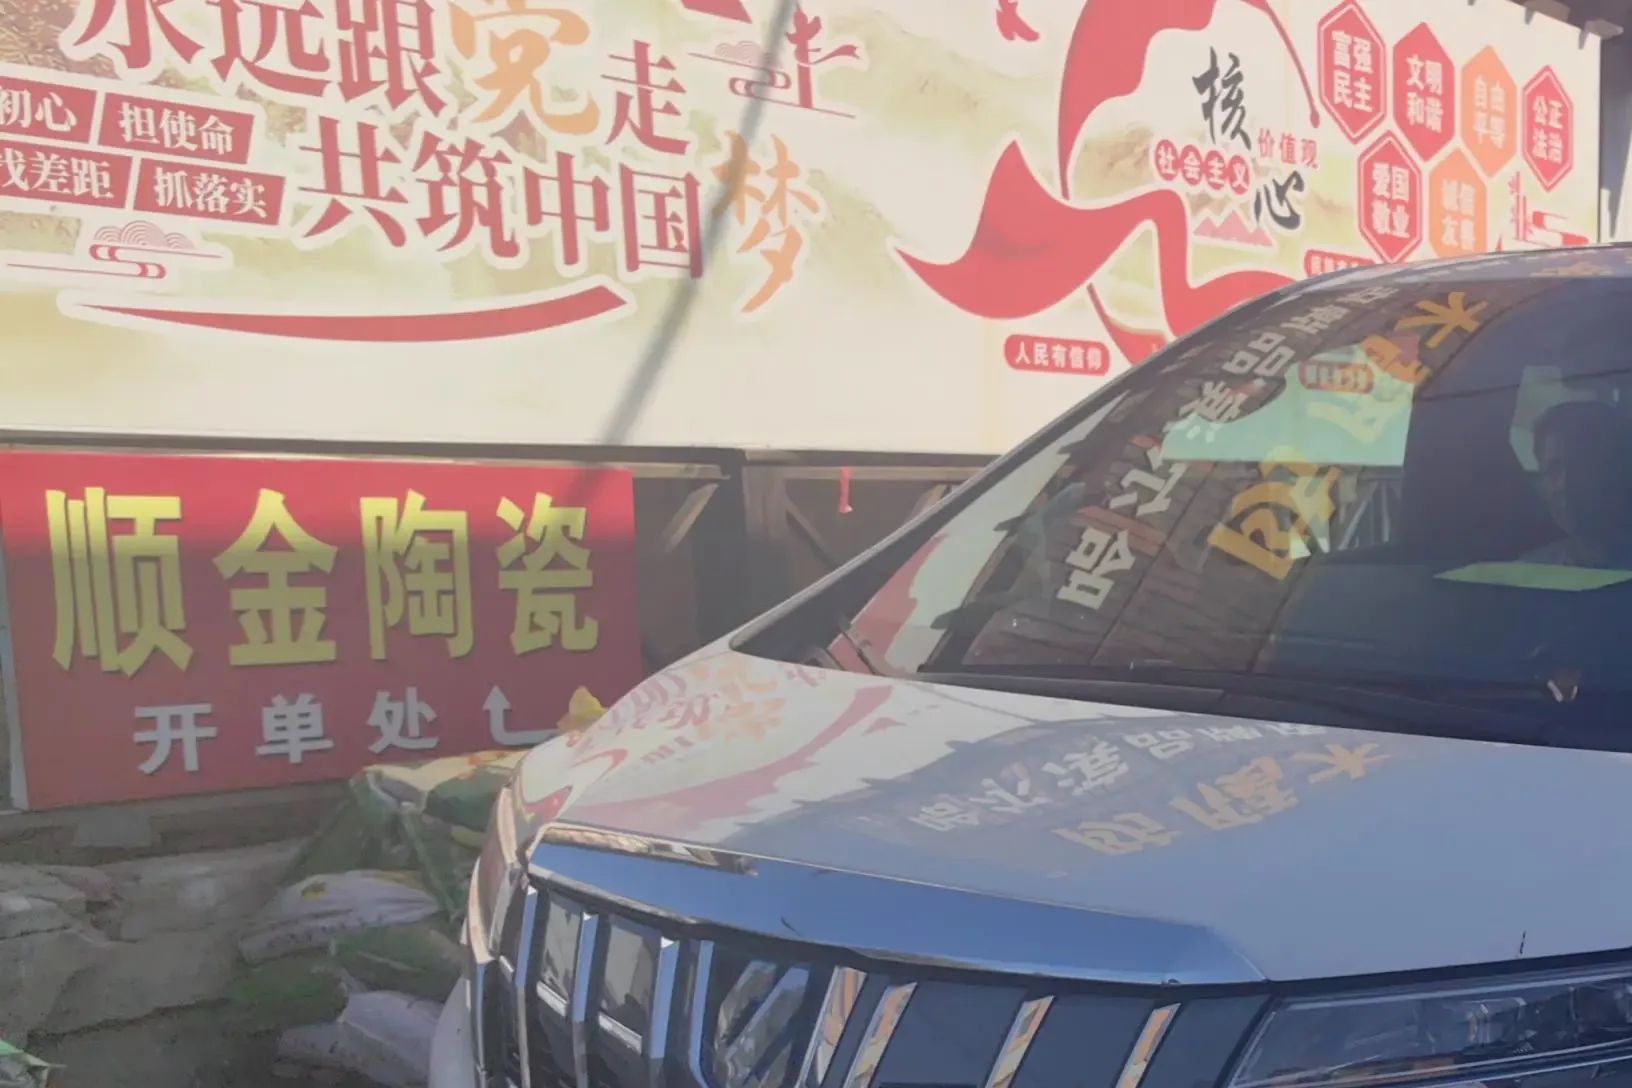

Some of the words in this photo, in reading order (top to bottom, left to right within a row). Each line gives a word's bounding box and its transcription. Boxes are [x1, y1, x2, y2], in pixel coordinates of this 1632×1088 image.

[1331, 30, 1374, 74] 富强
[1332, 70, 1373, 113] 民主
[1406, 54, 1443, 95] 文明
[1191, 46, 1252, 151] 核
[1406, 92, 1443, 133] 和谐
[1532, 95, 1563, 129] 公正
[118, 102, 235, 155] 担使命
[1157, 144, 1249, 189] 社会主义
[1372, 162, 1410, 203] 爱国
[153, 166, 268, 219] 抓落实
[298, 115, 820, 313] 共筑中国梦
[1014, 340, 1103, 370] 人民有信仰
[45, 486, 600, 677] 顺金陶瓷
[132, 686, 441, 775] 开单处
